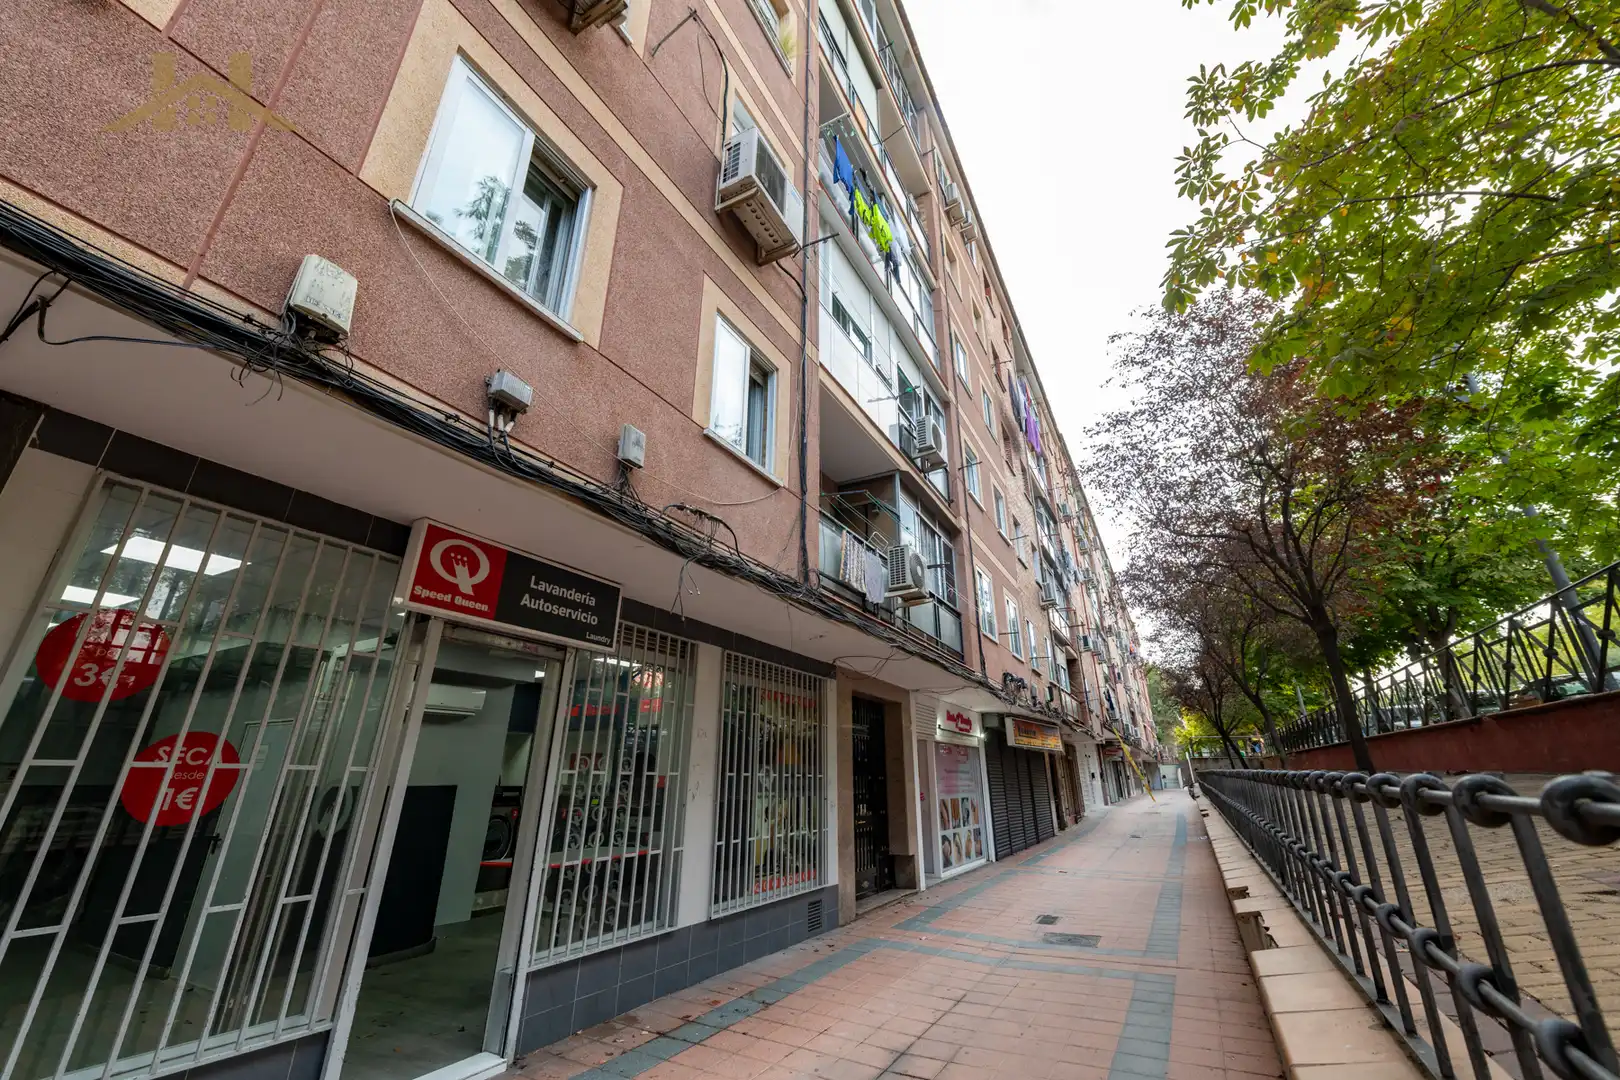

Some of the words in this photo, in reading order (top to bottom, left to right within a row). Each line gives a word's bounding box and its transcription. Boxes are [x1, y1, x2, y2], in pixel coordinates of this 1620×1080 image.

[413, 585, 453, 603] Speed
[454, 595, 490, 613] Queen
[530, 575, 597, 606] Lavandería
[520, 593, 598, 625] Autoservicio
[586, 631, 611, 645] Laundry
[170, 769, 205, 780] esde
